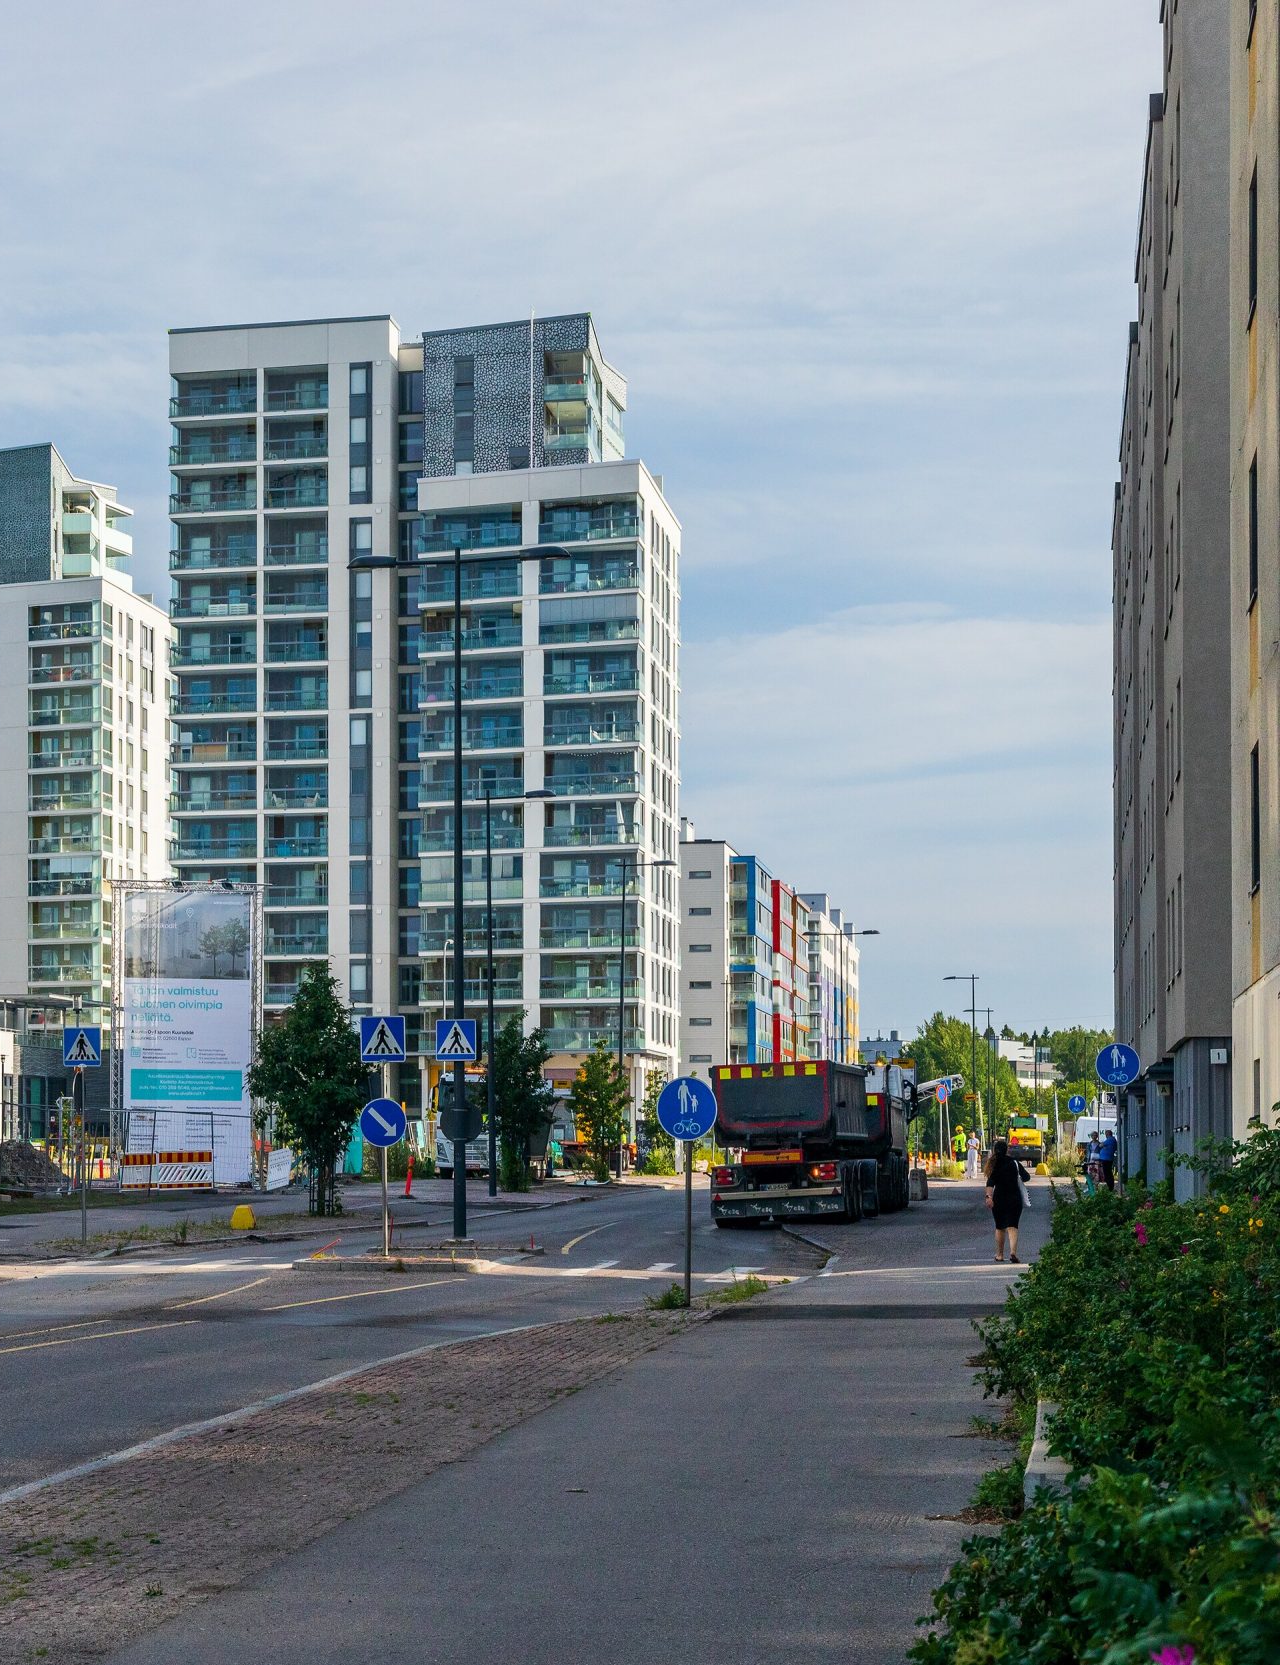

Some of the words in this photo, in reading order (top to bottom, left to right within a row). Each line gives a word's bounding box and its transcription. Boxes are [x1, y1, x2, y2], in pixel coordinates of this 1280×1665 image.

[167, 986, 219, 996] valmistuu
[131, 999, 176, 1009] Suomen
[178, 1000, 223, 1011] oivimpia
